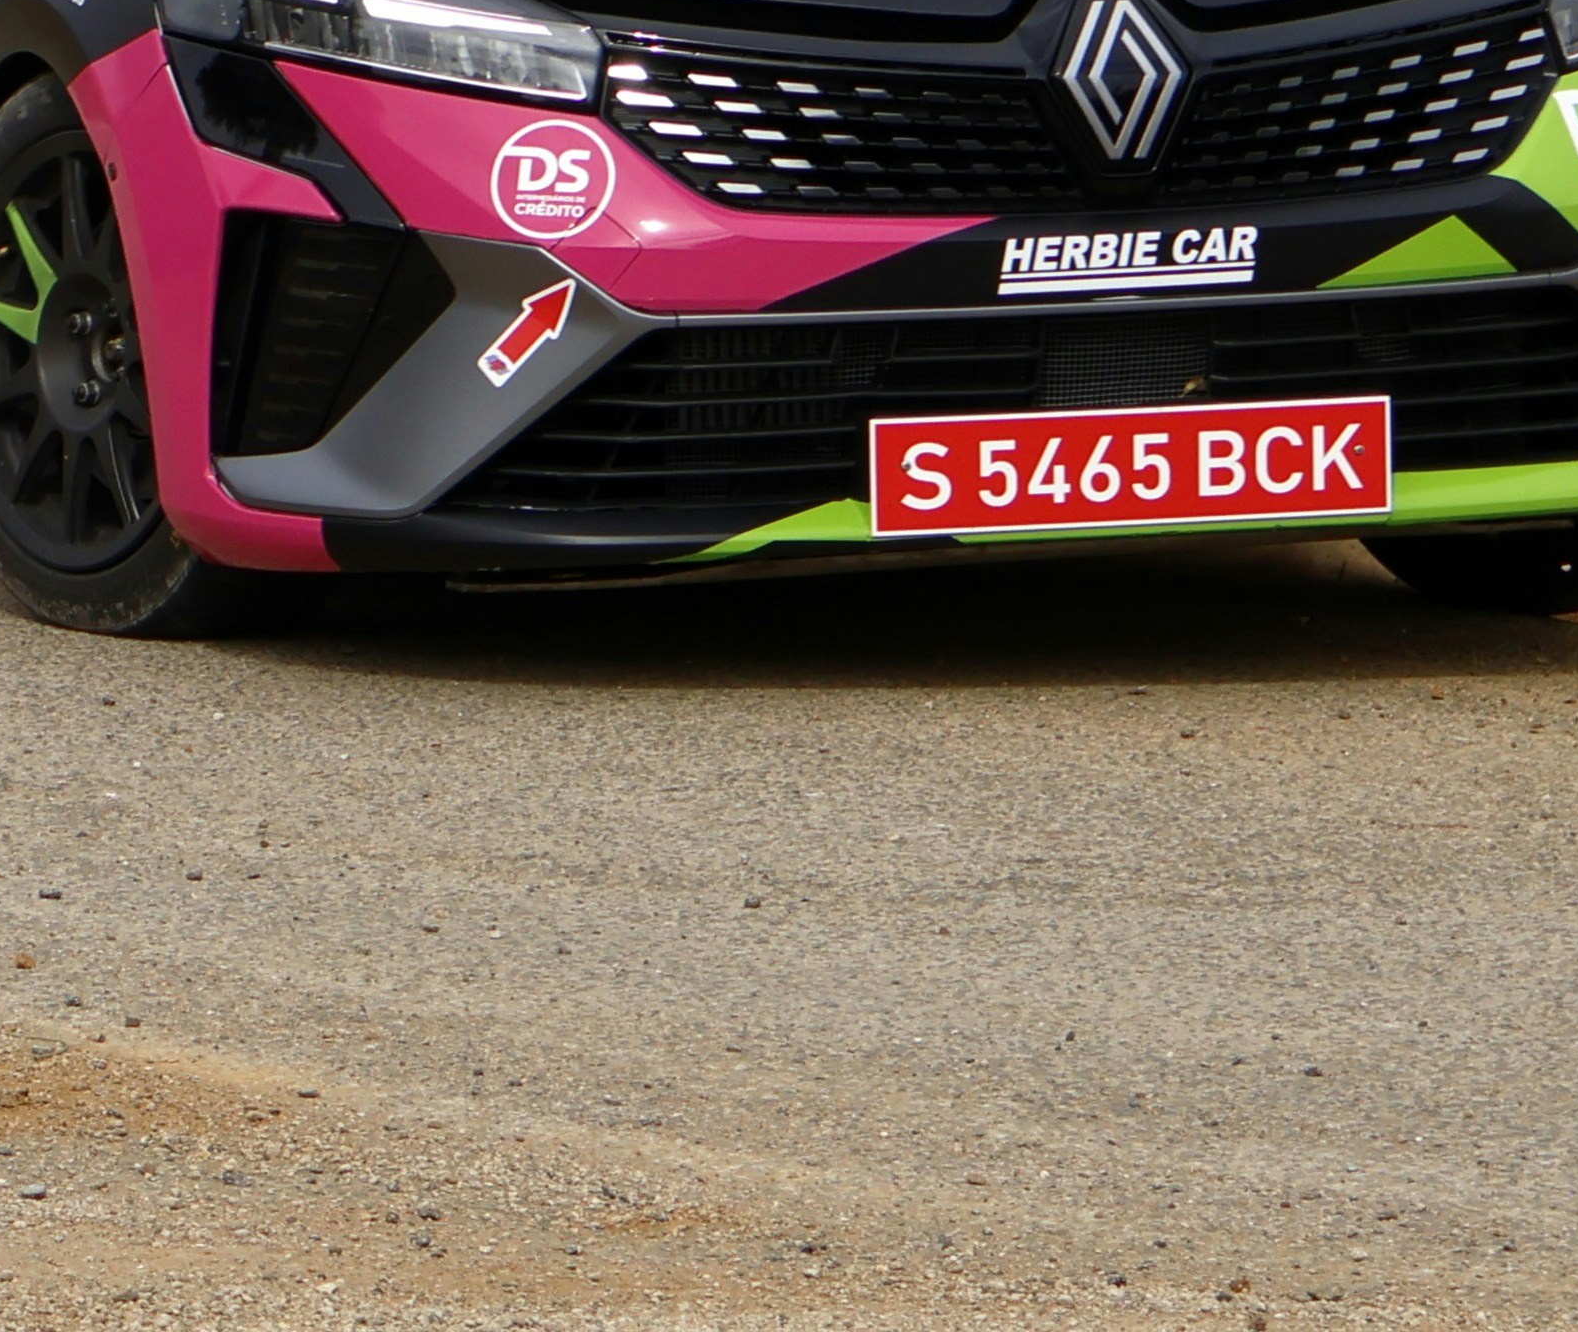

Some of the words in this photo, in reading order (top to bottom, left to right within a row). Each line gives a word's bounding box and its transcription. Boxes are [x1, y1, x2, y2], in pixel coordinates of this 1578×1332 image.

[504, 146, 591, 193] DS
[514, 199, 585, 219] CRÉDITO
[1001, 231, 1162, 273] HERBIE
[1172, 225, 1259, 265] CAR
[900, 441, 953, 511] S
[977, 433, 1172, 508] 5465
[1197, 422, 1365, 498] BCK
